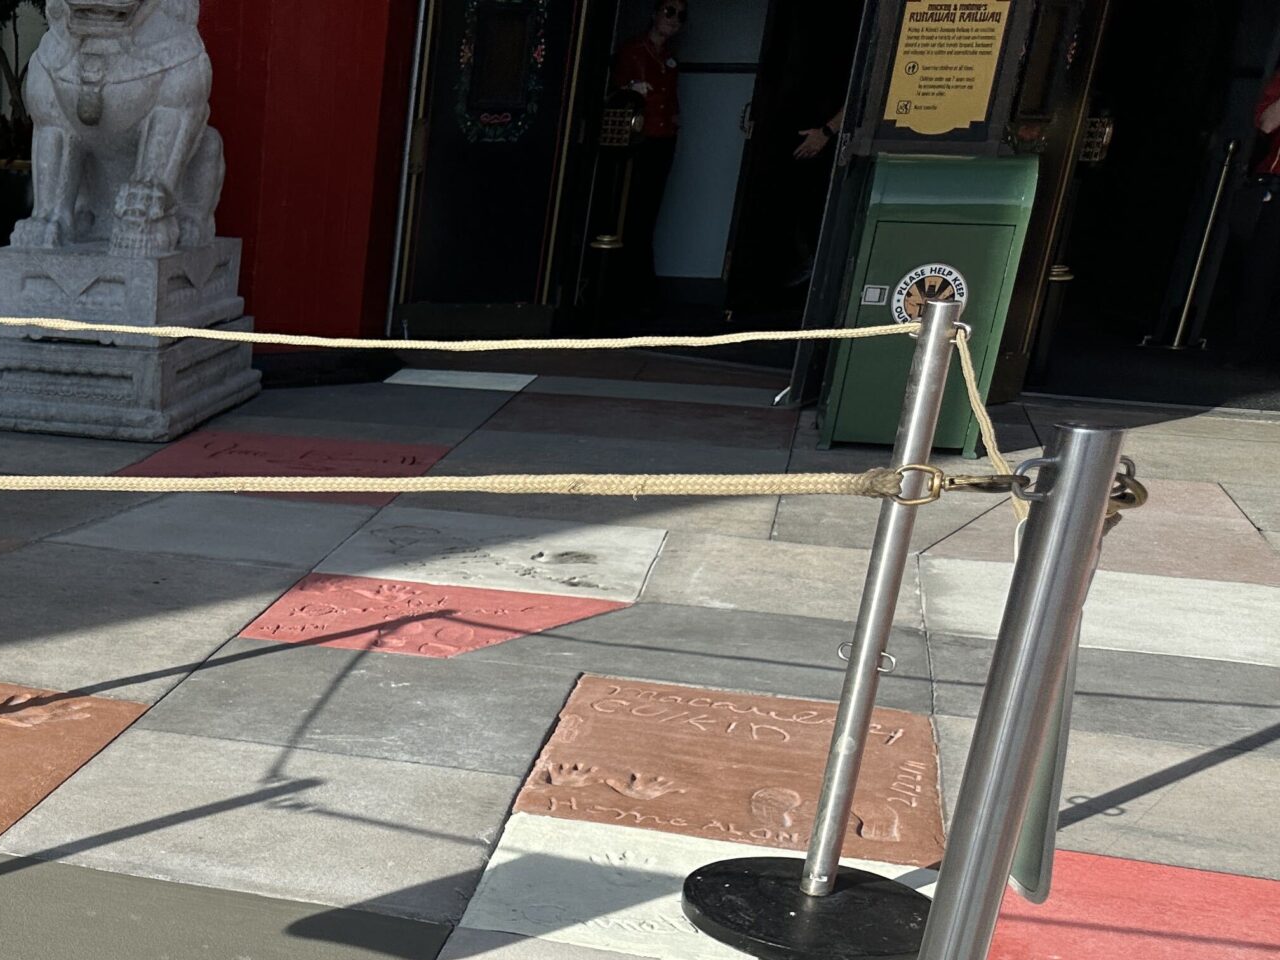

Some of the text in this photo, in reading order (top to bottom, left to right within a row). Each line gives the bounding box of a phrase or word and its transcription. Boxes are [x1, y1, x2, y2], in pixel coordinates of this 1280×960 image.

[908, 11, 1002, 23] RUNAWAY RAILWAY
[896, 266, 965, 298] PLEASE HELP KEEP
